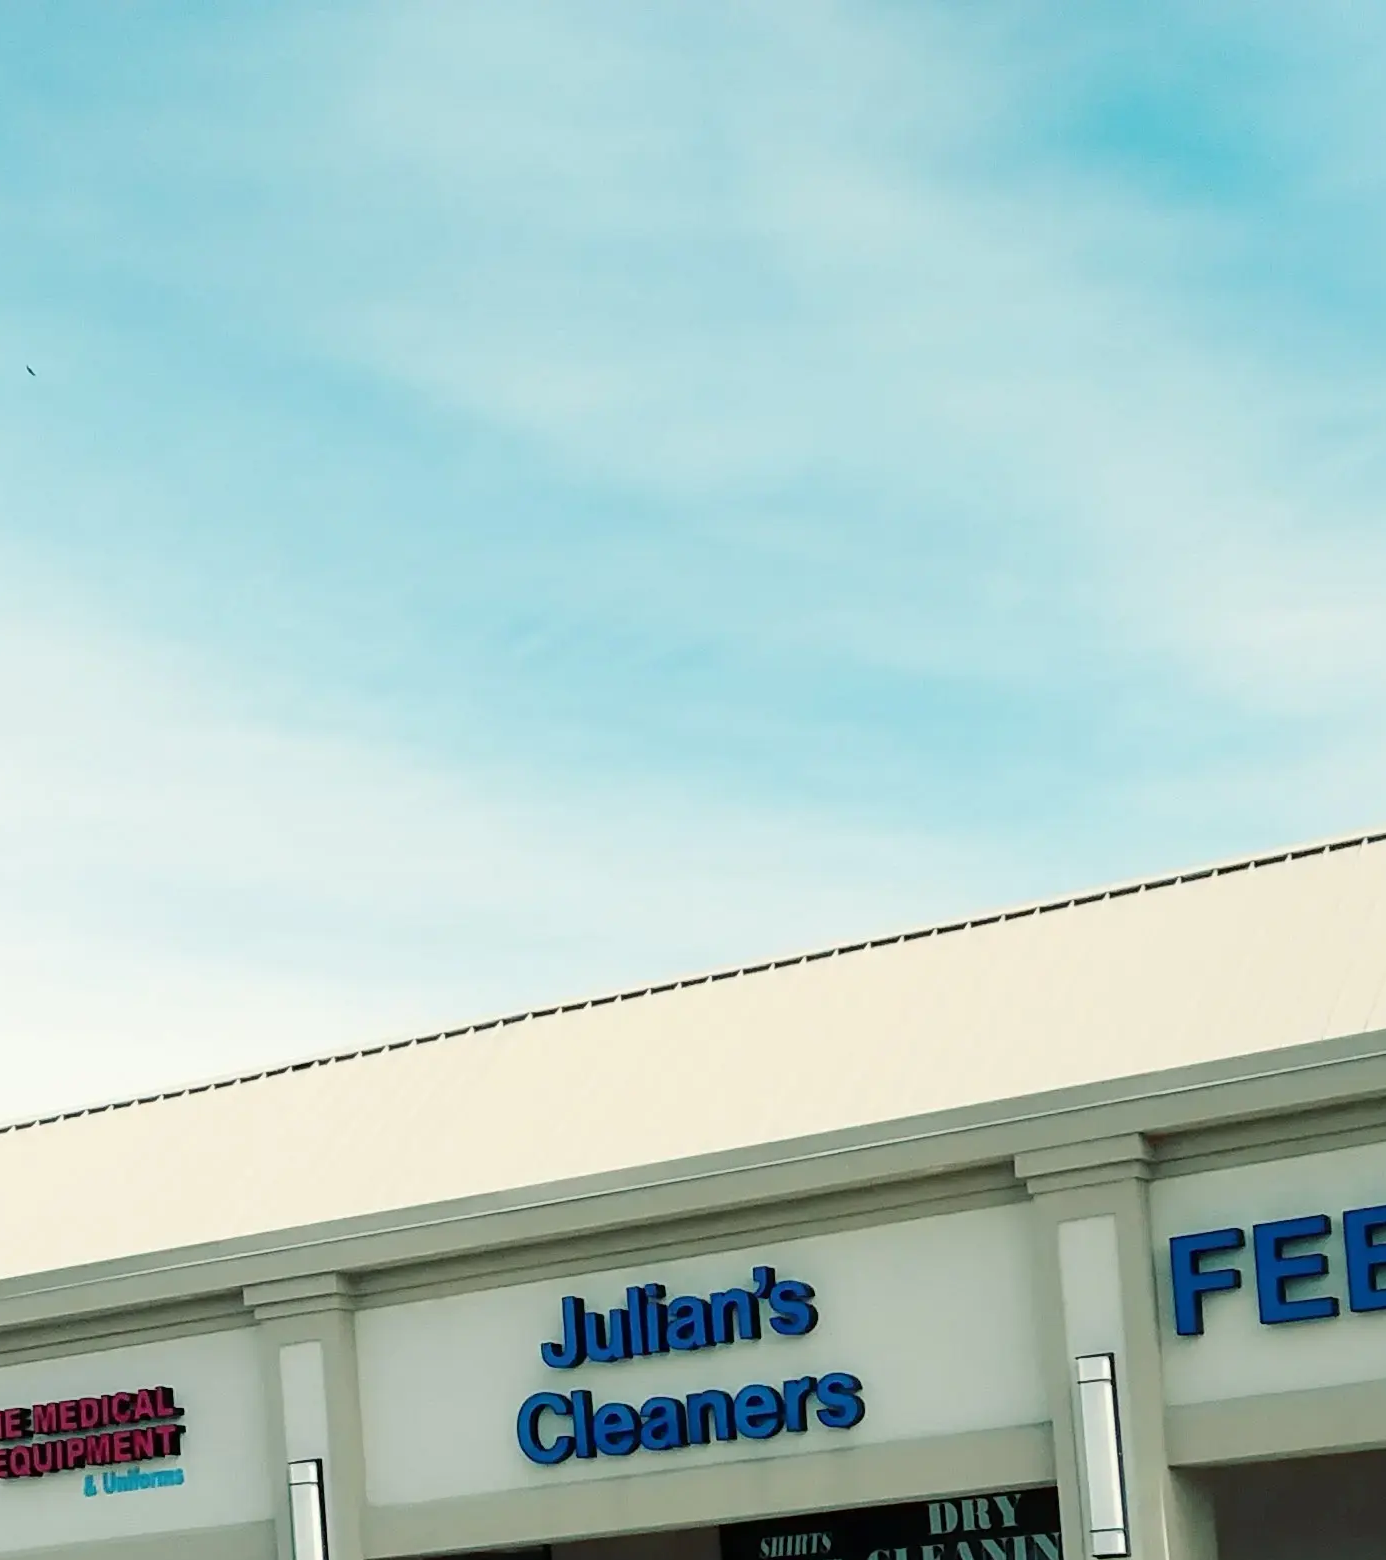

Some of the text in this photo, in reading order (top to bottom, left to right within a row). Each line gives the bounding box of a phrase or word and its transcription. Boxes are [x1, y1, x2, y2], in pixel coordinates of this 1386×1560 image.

[540, 1265, 819, 1369] Julian's
[32, 1386, 185, 1435] MEDICAL
[516, 1371, 866, 1465] Cleaners
[102, 1466, 186, 1496] Uniforms
[926, 1493, 1022, 1536] DRY
[759, 1530, 833, 1559] SHIRTS
